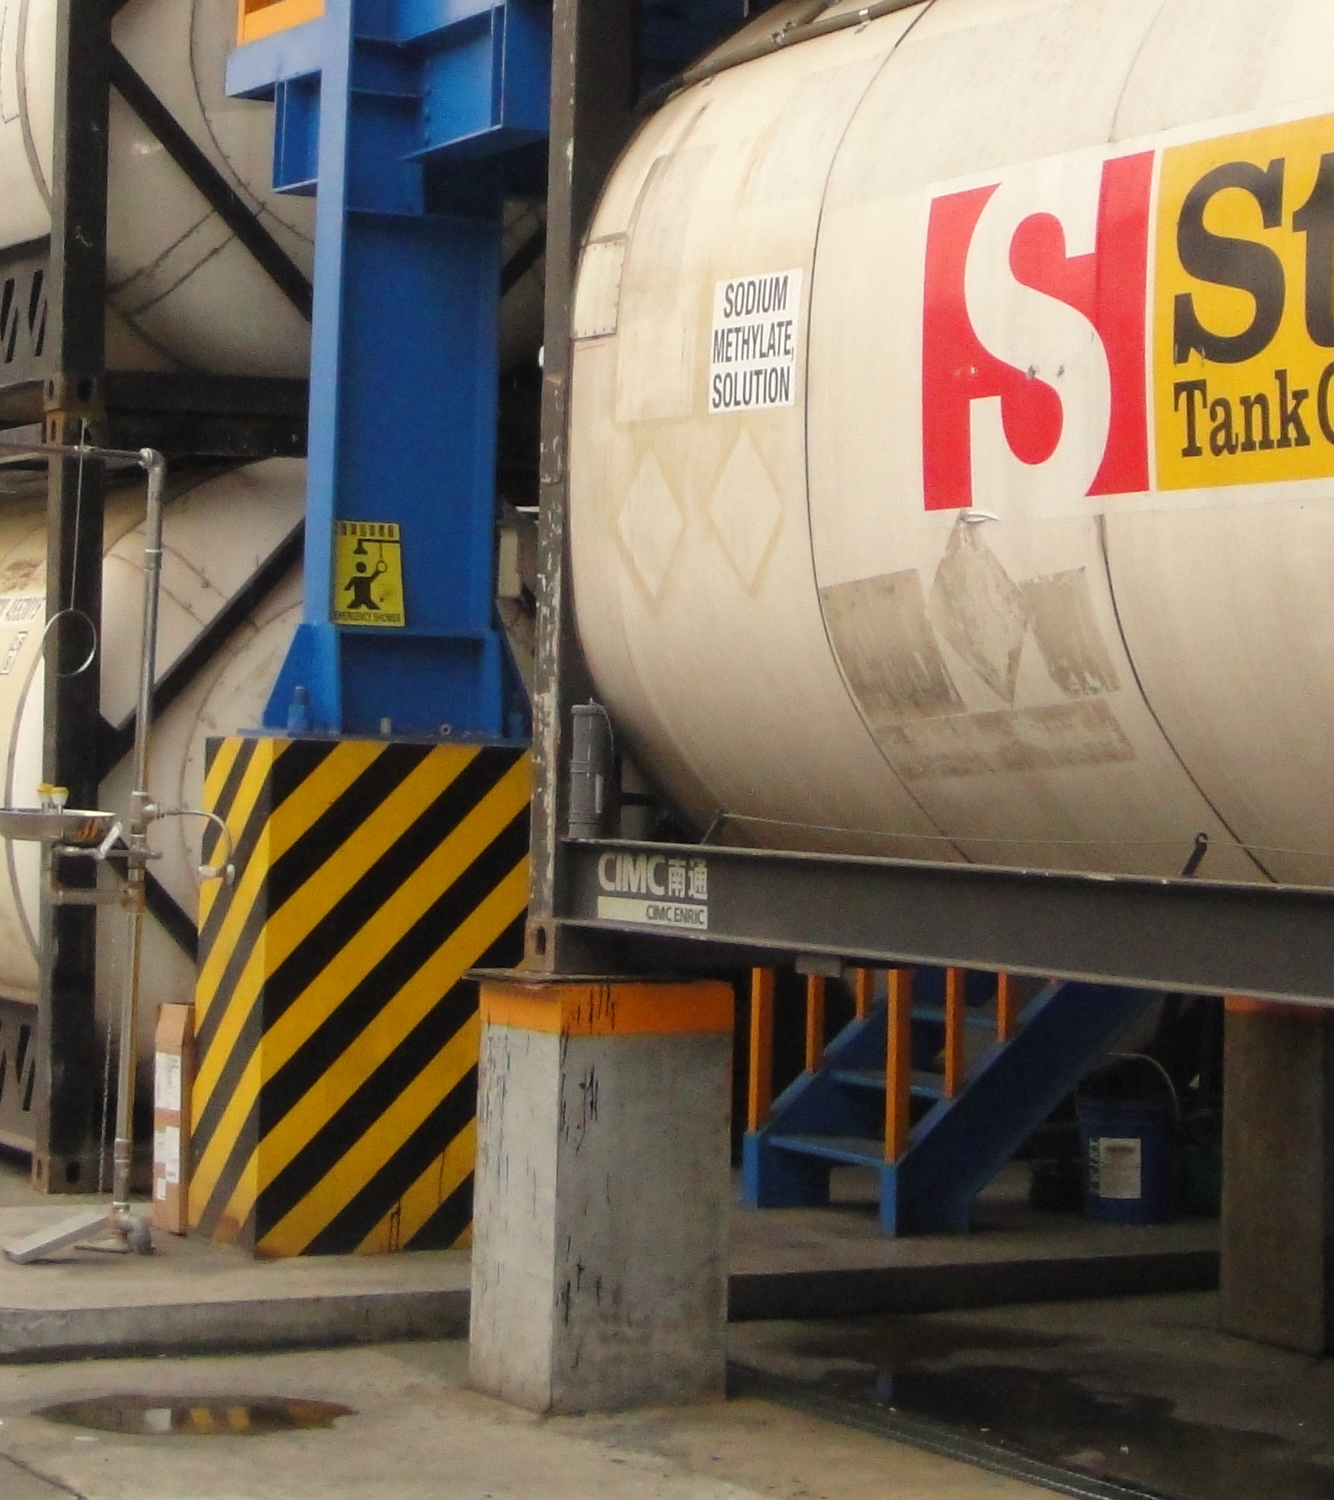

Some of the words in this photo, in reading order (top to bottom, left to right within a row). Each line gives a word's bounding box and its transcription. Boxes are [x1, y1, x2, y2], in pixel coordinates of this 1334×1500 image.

[723, 274, 789, 318] SODIUM
[713, 319, 794, 364] METHYLATE,
[712, 365, 791, 409] SOLUTION
[1173, 369, 1310, 459] Tank
[598, 852, 665, 896] CIMC
[646, 904, 672, 922] CIMC
[674, 906, 706, 926] ENRIC
